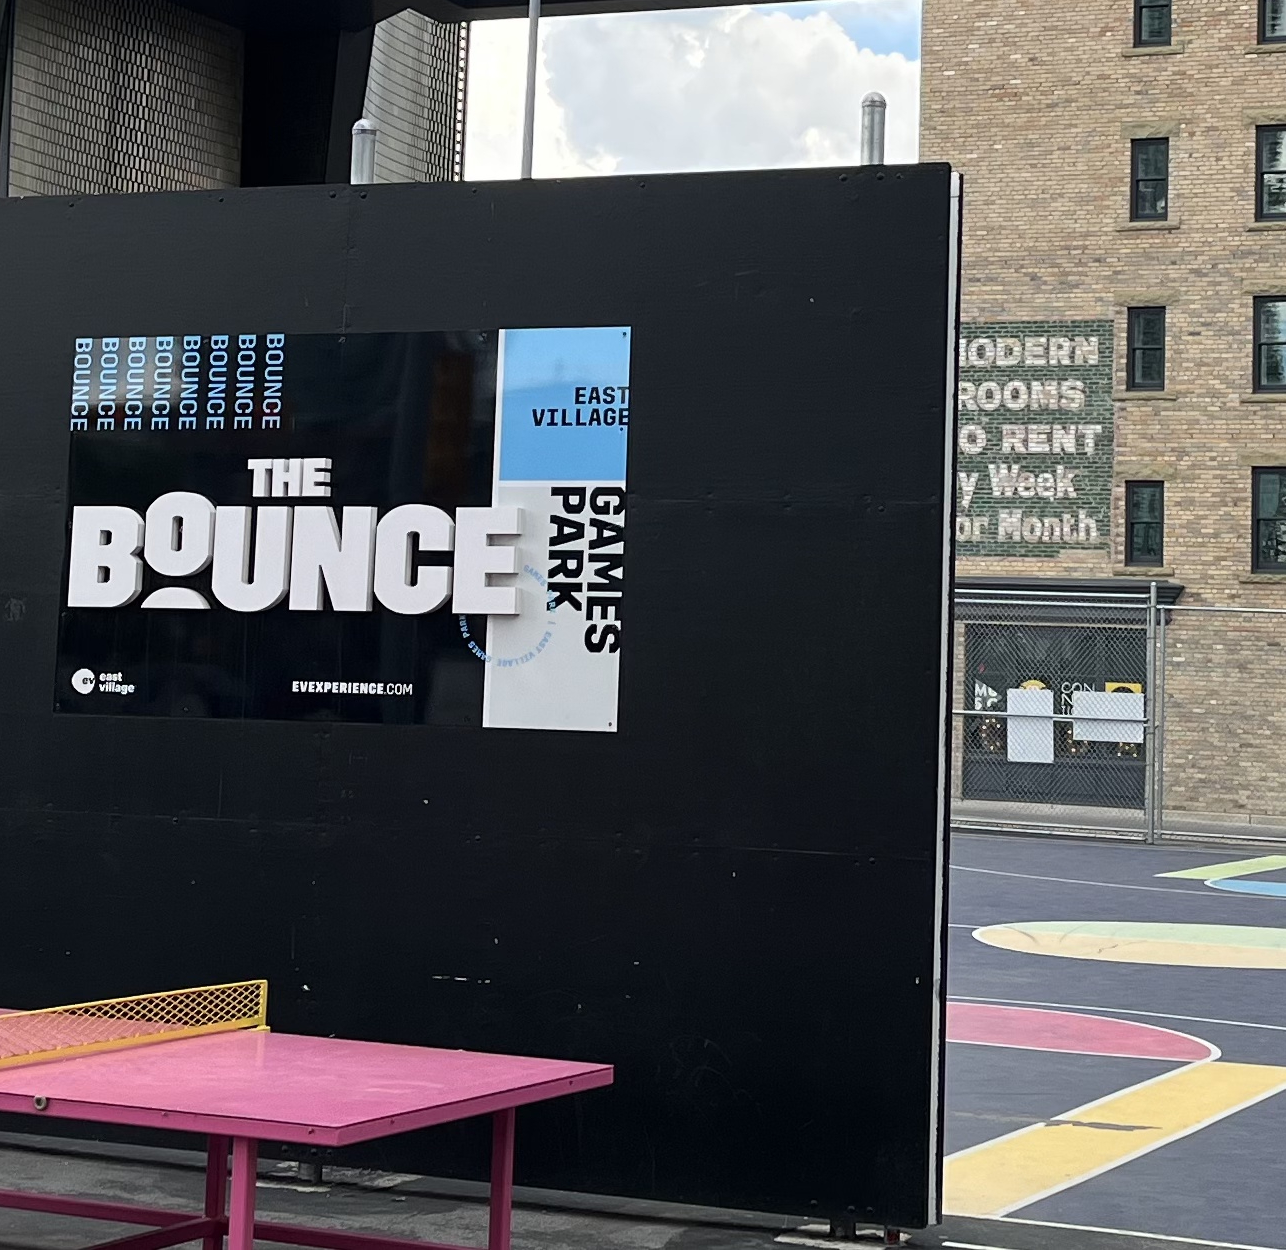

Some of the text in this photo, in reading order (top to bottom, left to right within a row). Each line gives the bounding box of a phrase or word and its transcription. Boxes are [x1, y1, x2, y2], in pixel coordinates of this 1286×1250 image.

[97, 337, 119, 431] BOUNCE
[124, 337, 146, 431] BOUNCE
[151, 336, 174, 431] BOUNCE
[178, 335, 201, 430] BOUNCE
[206, 334, 229, 430] BOUNCE
[234, 334, 257, 430] BOUNCE
[262, 333, 285, 429] BOUNCE
[959, 336, 1099, 366] ODERN
[70, 338, 92, 431] BOUNCE
[532, 408, 630, 427] VILLAGE
[575, 386, 630, 405] EAST
[958, 379, 1086, 412] ROOMS
[1001, 424, 1102, 455] RENT
[247, 457, 332, 497] THE
[988, 464, 1081, 499] Week
[68, 491, 522, 615] BOUNCE
[547, 487, 587, 612] PARK
[997, 509, 1098, 543] Month
[585, 487, 627, 654] GAMES
[98, 681, 135, 695] village
[99, 671, 123, 682] east
[291, 680, 413, 696] EVEXPERIENCE.COM
